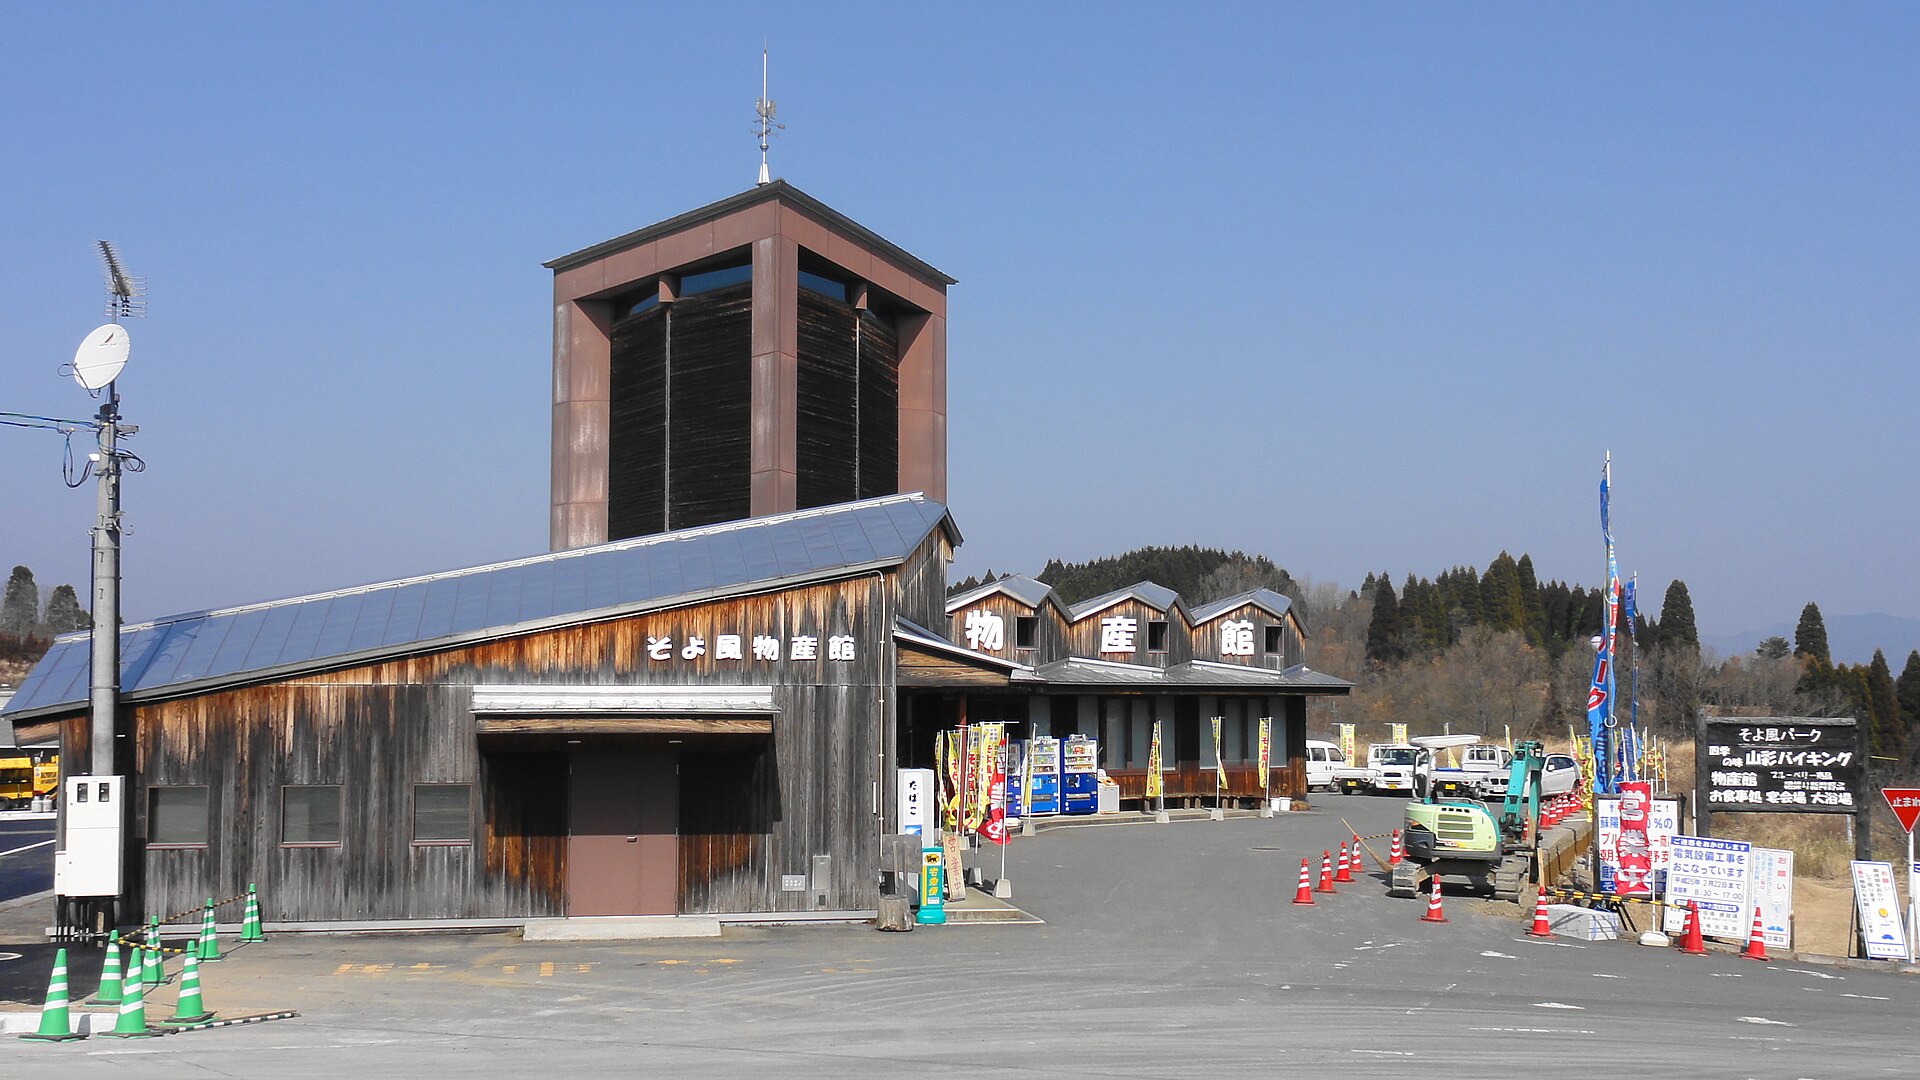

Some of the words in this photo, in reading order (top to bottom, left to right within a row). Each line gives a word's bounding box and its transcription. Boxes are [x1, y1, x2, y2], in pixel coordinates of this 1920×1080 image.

[965, 609, 1004, 651] 物
[1100, 615, 1138, 653] 産
[1220, 619, 1255, 656] 館
[647, 634, 856, 661] そよ風物産館
[1738, 728, 1822, 743] そよ風パーク
[1745, 750, 1853, 767] 山彩バイキング
[1711, 771, 1758, 787] 物産館
[908, 780, 918, 815] たばこ
[1709, 789, 1763, 804] お食事処
[1765, 790, 1807, 805] 宴会場
[1810, 791, 1853, 806] 大浴場
[1620, 790, 1648, 888] 営業中
[1673, 848, 1745, 865] 電気設備工事を
[1672, 863, 1745, 878] おこなっています
